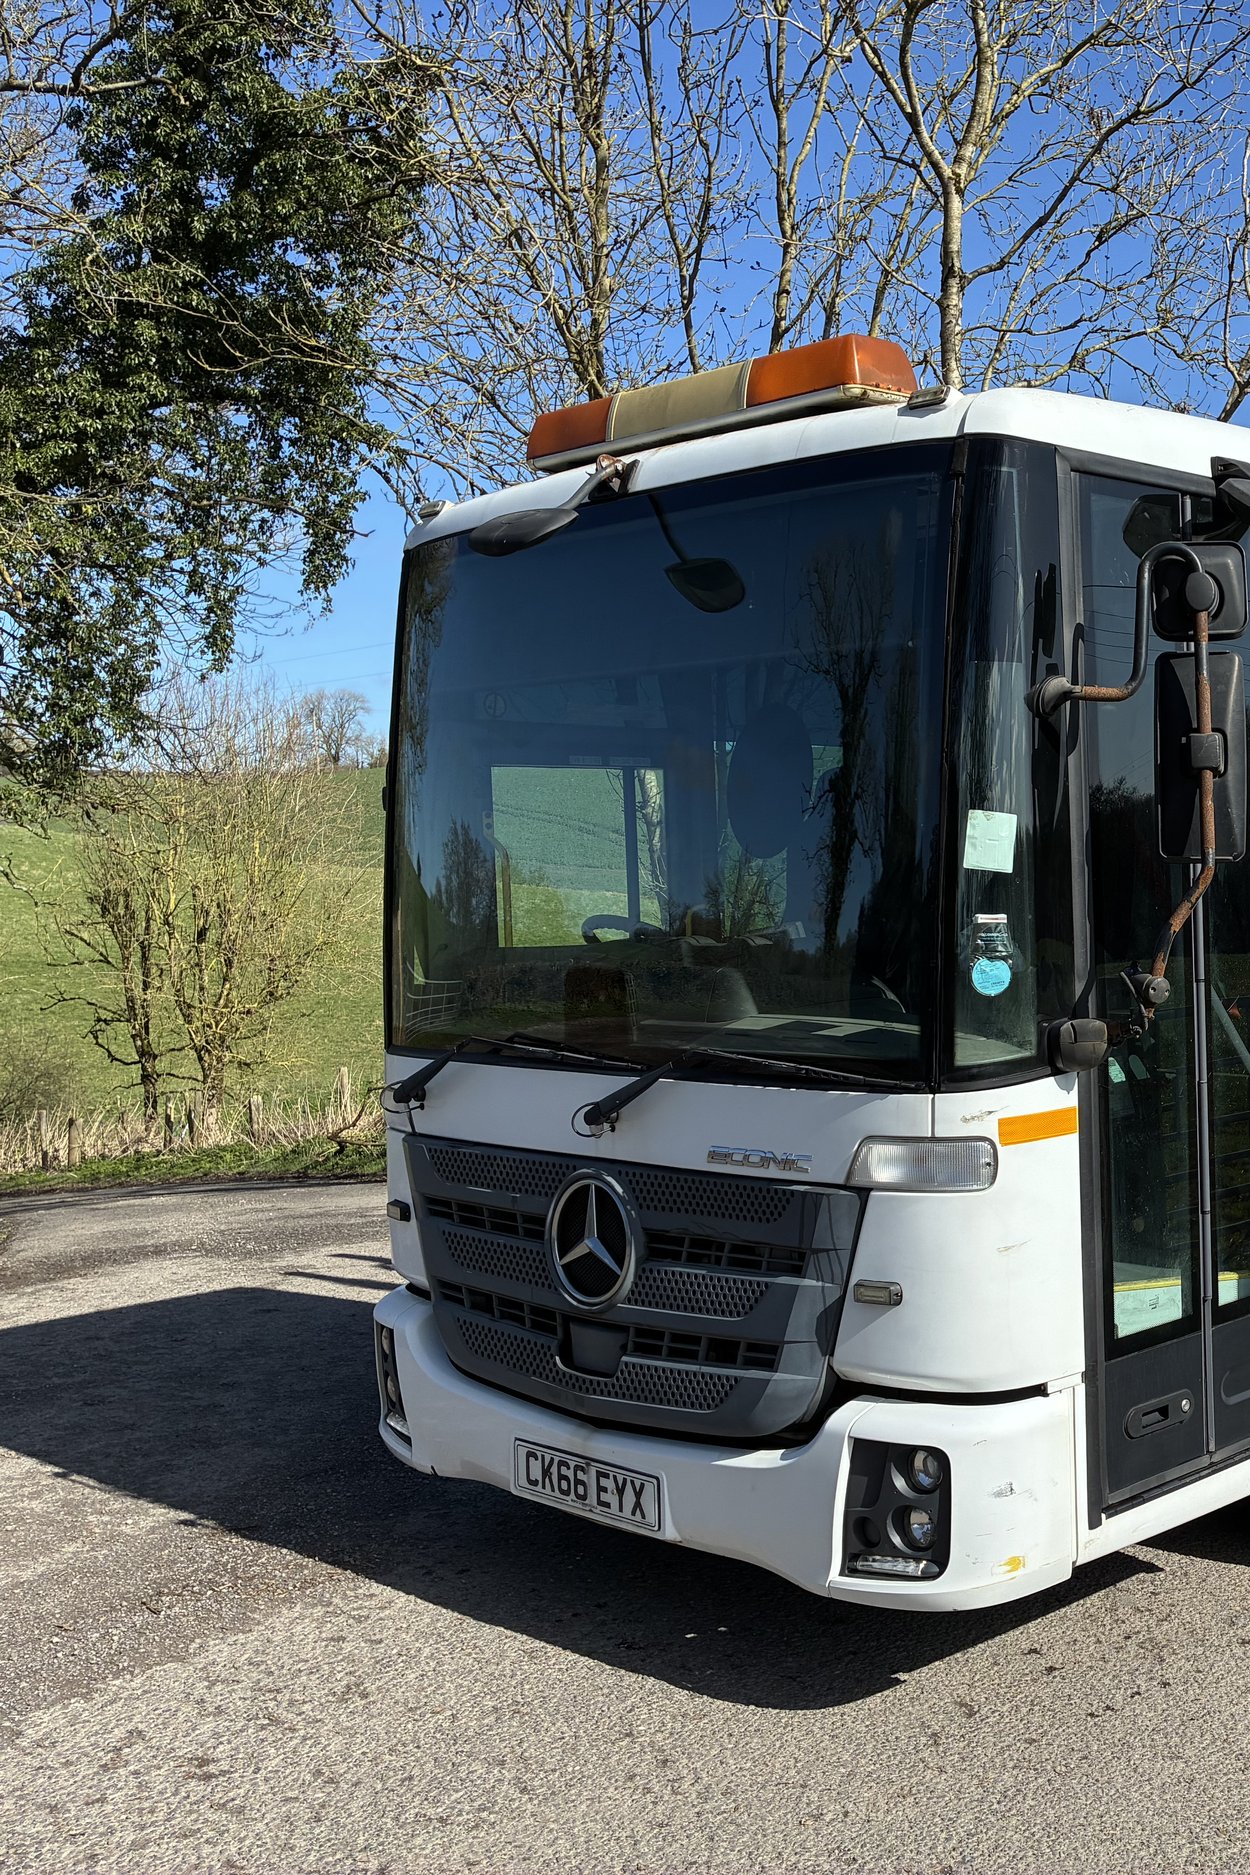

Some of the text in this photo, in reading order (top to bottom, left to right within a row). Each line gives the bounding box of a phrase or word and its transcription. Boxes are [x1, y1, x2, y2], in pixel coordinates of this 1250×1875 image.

[706, 1145, 813, 1174] ECONIC
[525, 1450, 647, 1520] CK66 EYX
